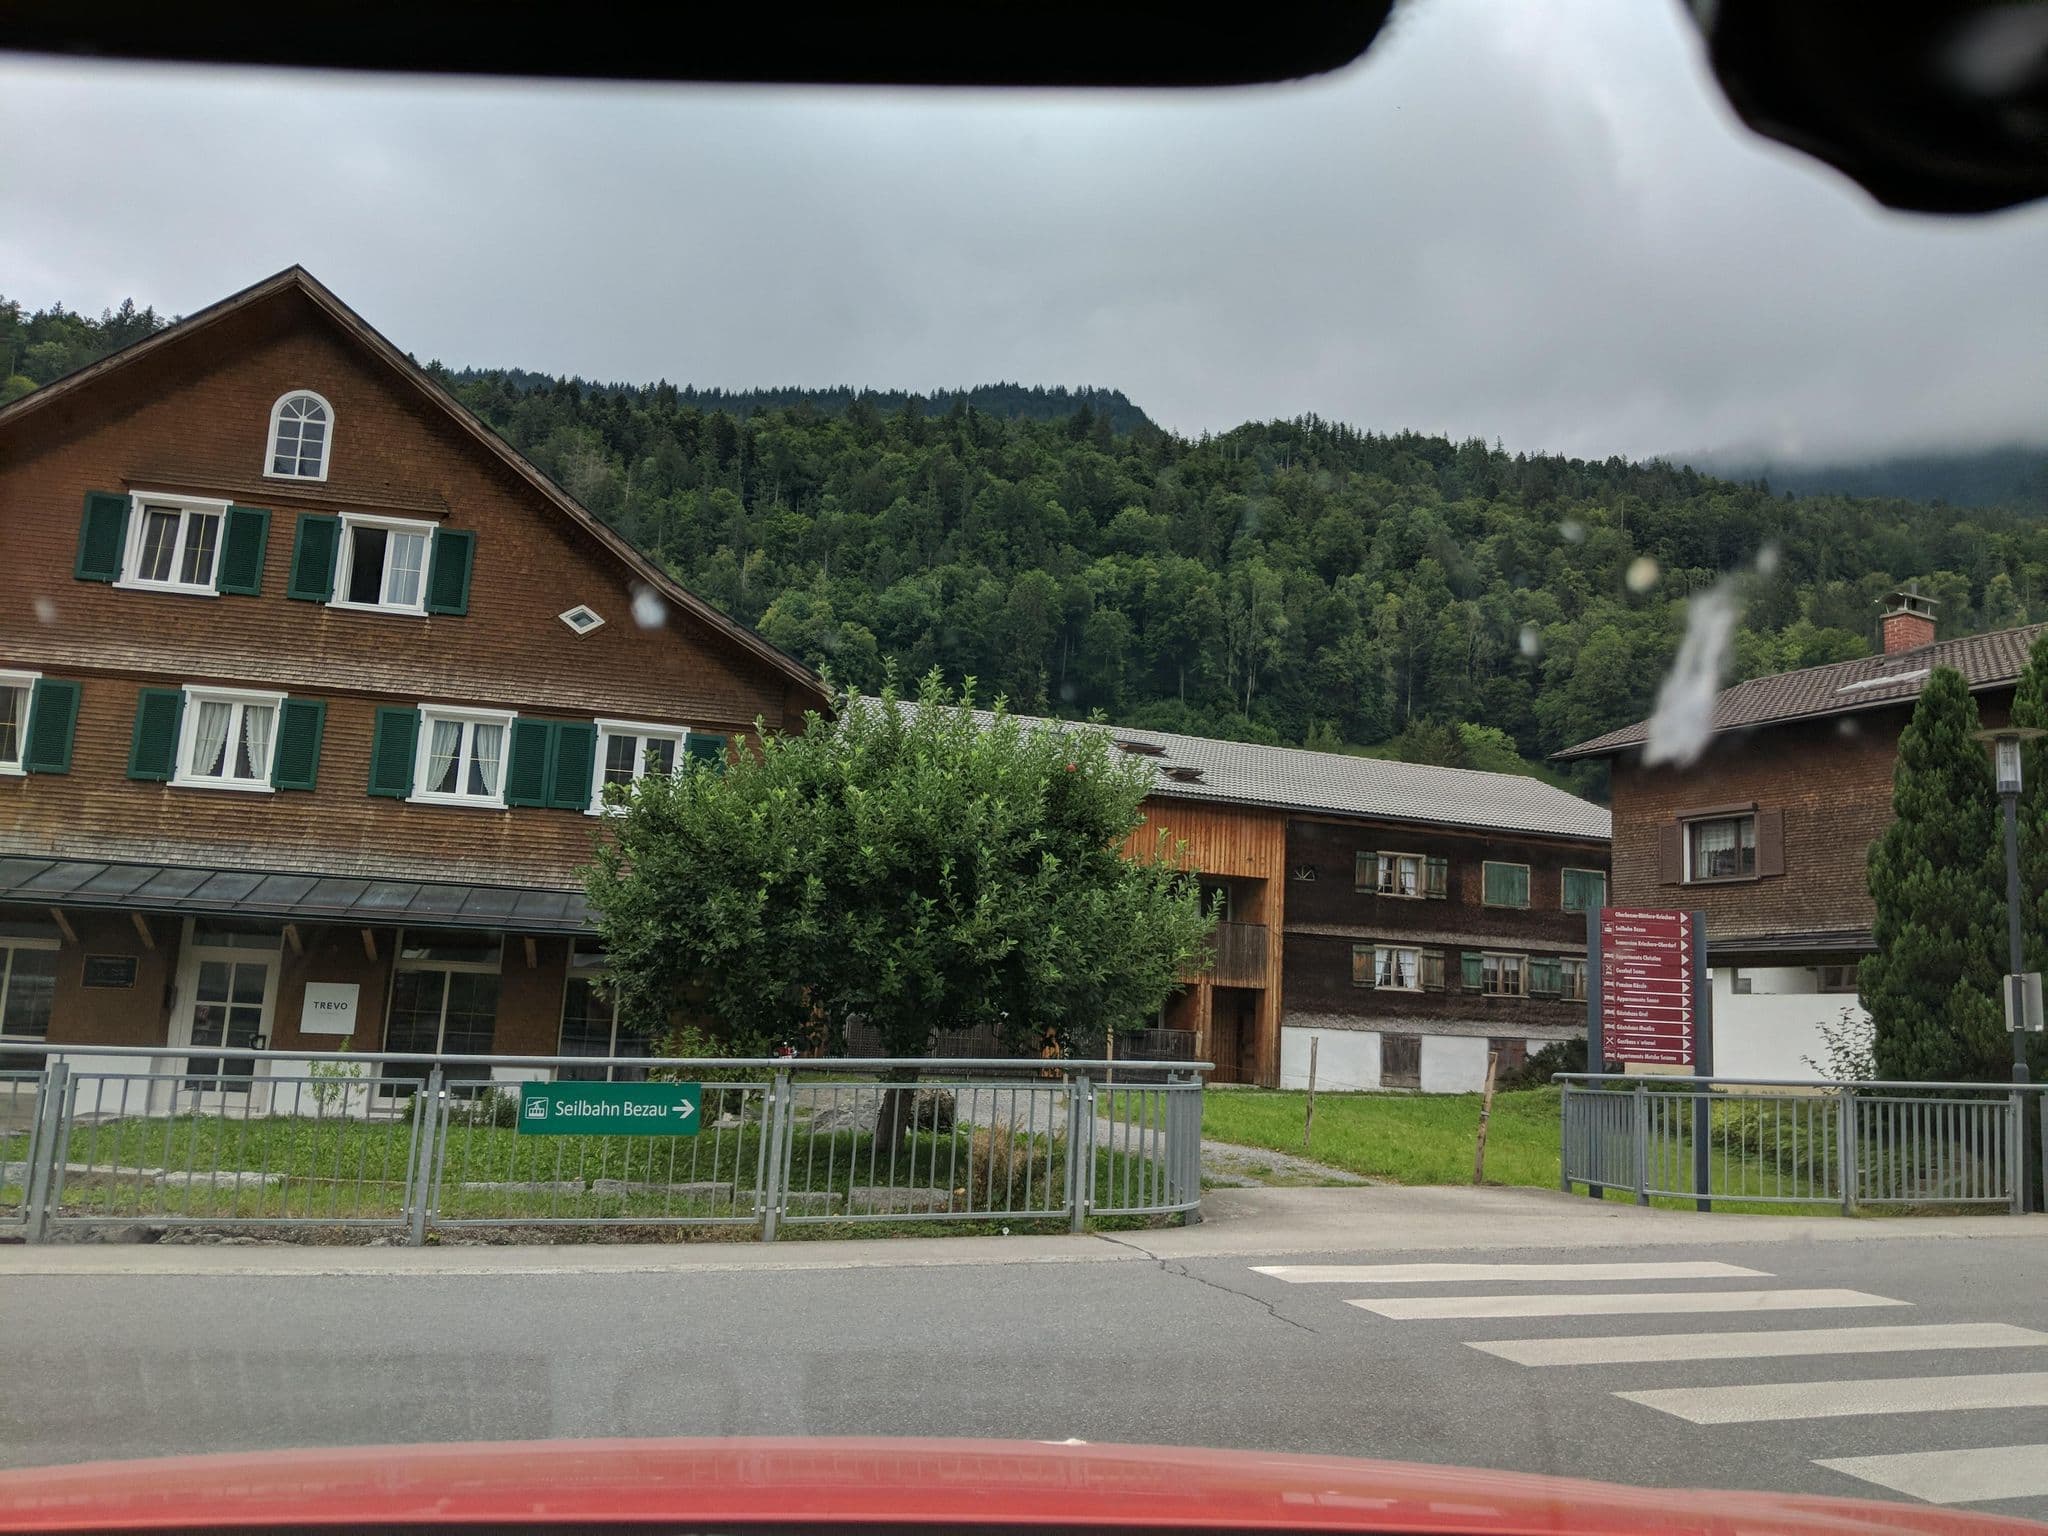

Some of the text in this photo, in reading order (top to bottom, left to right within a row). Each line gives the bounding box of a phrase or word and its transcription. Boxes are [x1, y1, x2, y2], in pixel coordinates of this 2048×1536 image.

[313, 1001, 348, 1010] TREVO
[555, 1100, 667, 1117] Seilbahn Bezau
